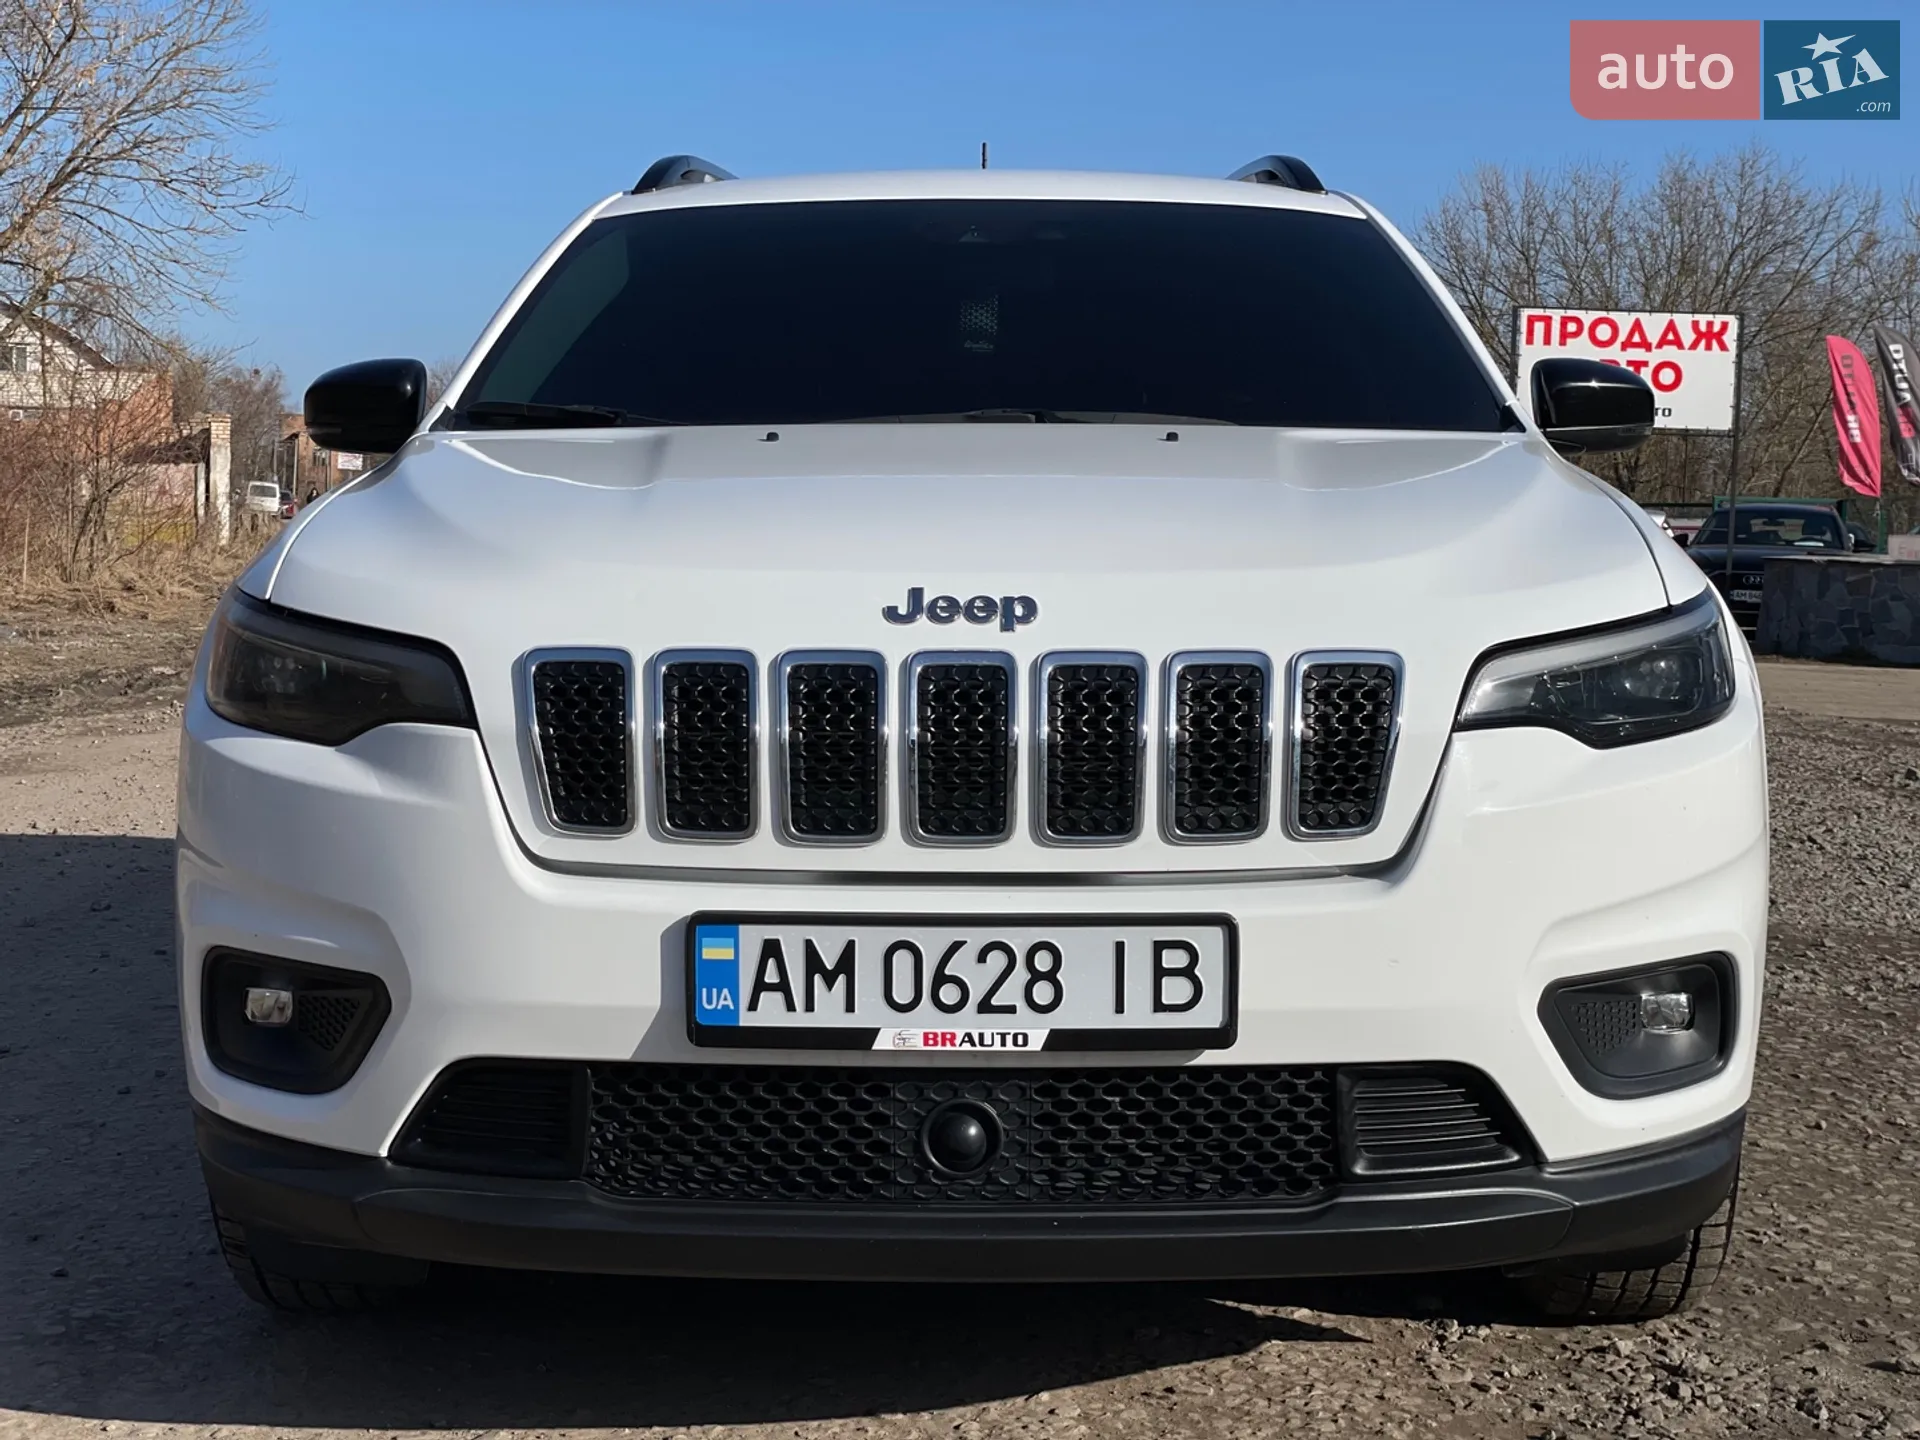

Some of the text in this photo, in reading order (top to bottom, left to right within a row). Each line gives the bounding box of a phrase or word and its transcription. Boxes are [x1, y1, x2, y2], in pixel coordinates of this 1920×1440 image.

[1525, 314, 1729, 353] ПРОДАЖ
[882, 587, 1038, 632] Jeep
[746, 938, 1204, 1015] AM 0628 IB
[701, 988, 734, 1011] UA
[923, 1031, 1029, 1048] BRAUTO
